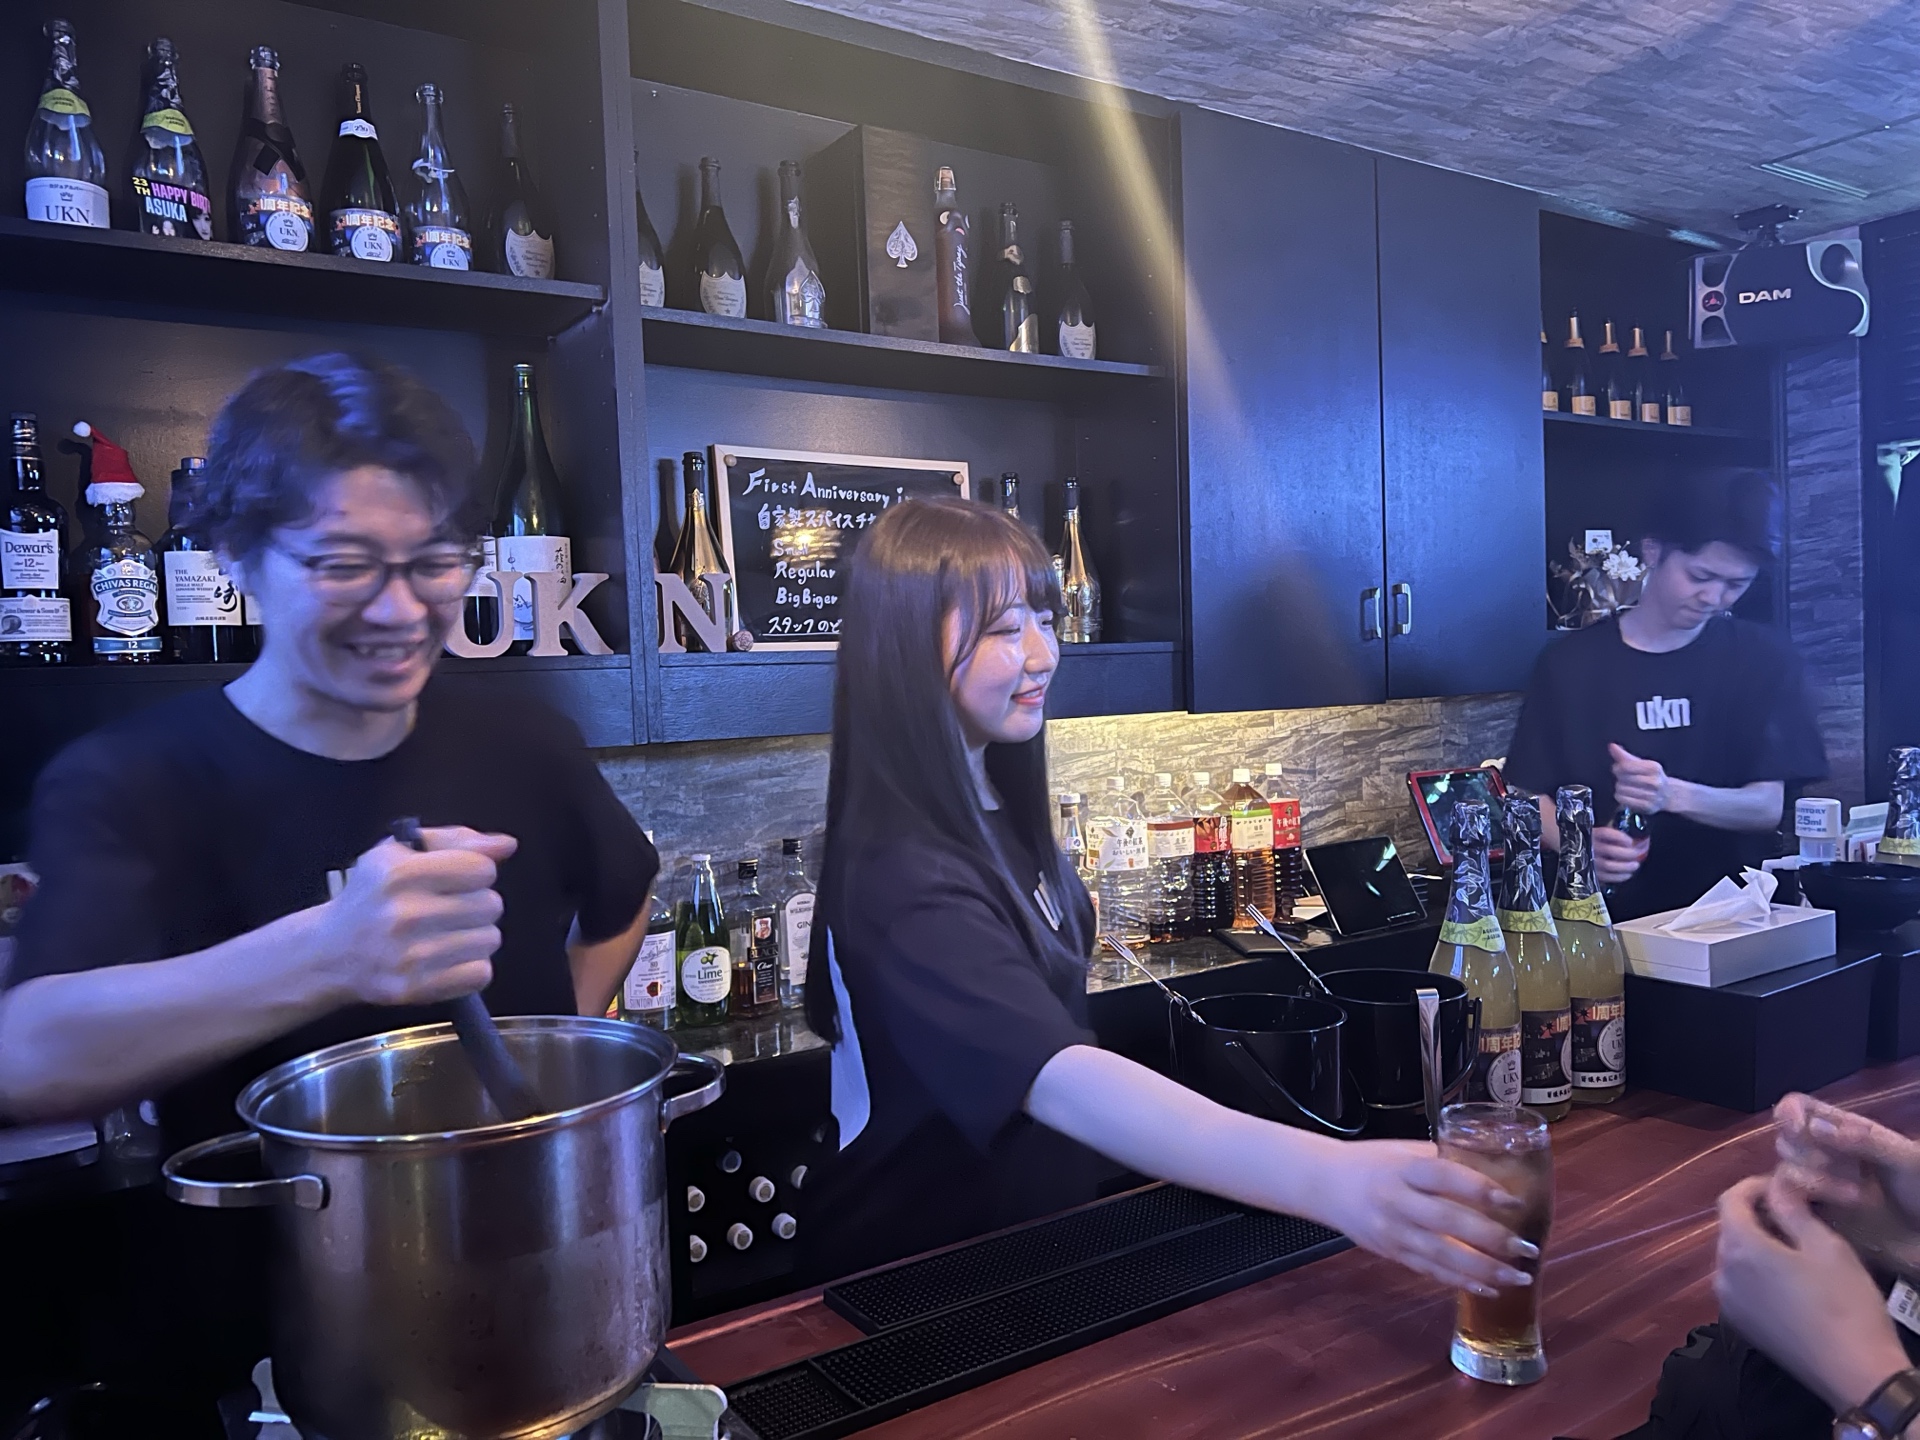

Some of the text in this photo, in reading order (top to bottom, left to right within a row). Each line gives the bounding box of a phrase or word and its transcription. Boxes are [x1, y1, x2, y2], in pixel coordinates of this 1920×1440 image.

[132, 177, 149, 186] 23
[134, 186, 151, 196] TH
[150, 182, 188, 205] HAPPY
[145, 196, 188, 222] ASUKA
[953, 272, 964, 286] the
[953, 287, 970, 315] Just
[1738, 288, 1792, 304] DAM
[742, 467, 797, 496] First
[800, 472, 890, 508] Anniversary
[4, 541, 55, 554] Dewar's
[24, 558, 35, 567] 12
[774, 561, 836, 585] Regular
[95, 579, 131, 592] CHIVAS
[132, 579, 157, 593] REGAL
[127, 641, 138, 649] 12
[1635, 695, 1691, 730] ukn
[797, 921, 811, 929] GIN
[750, 947, 779, 958] BLACK
[697, 969, 723, 980] Lime
